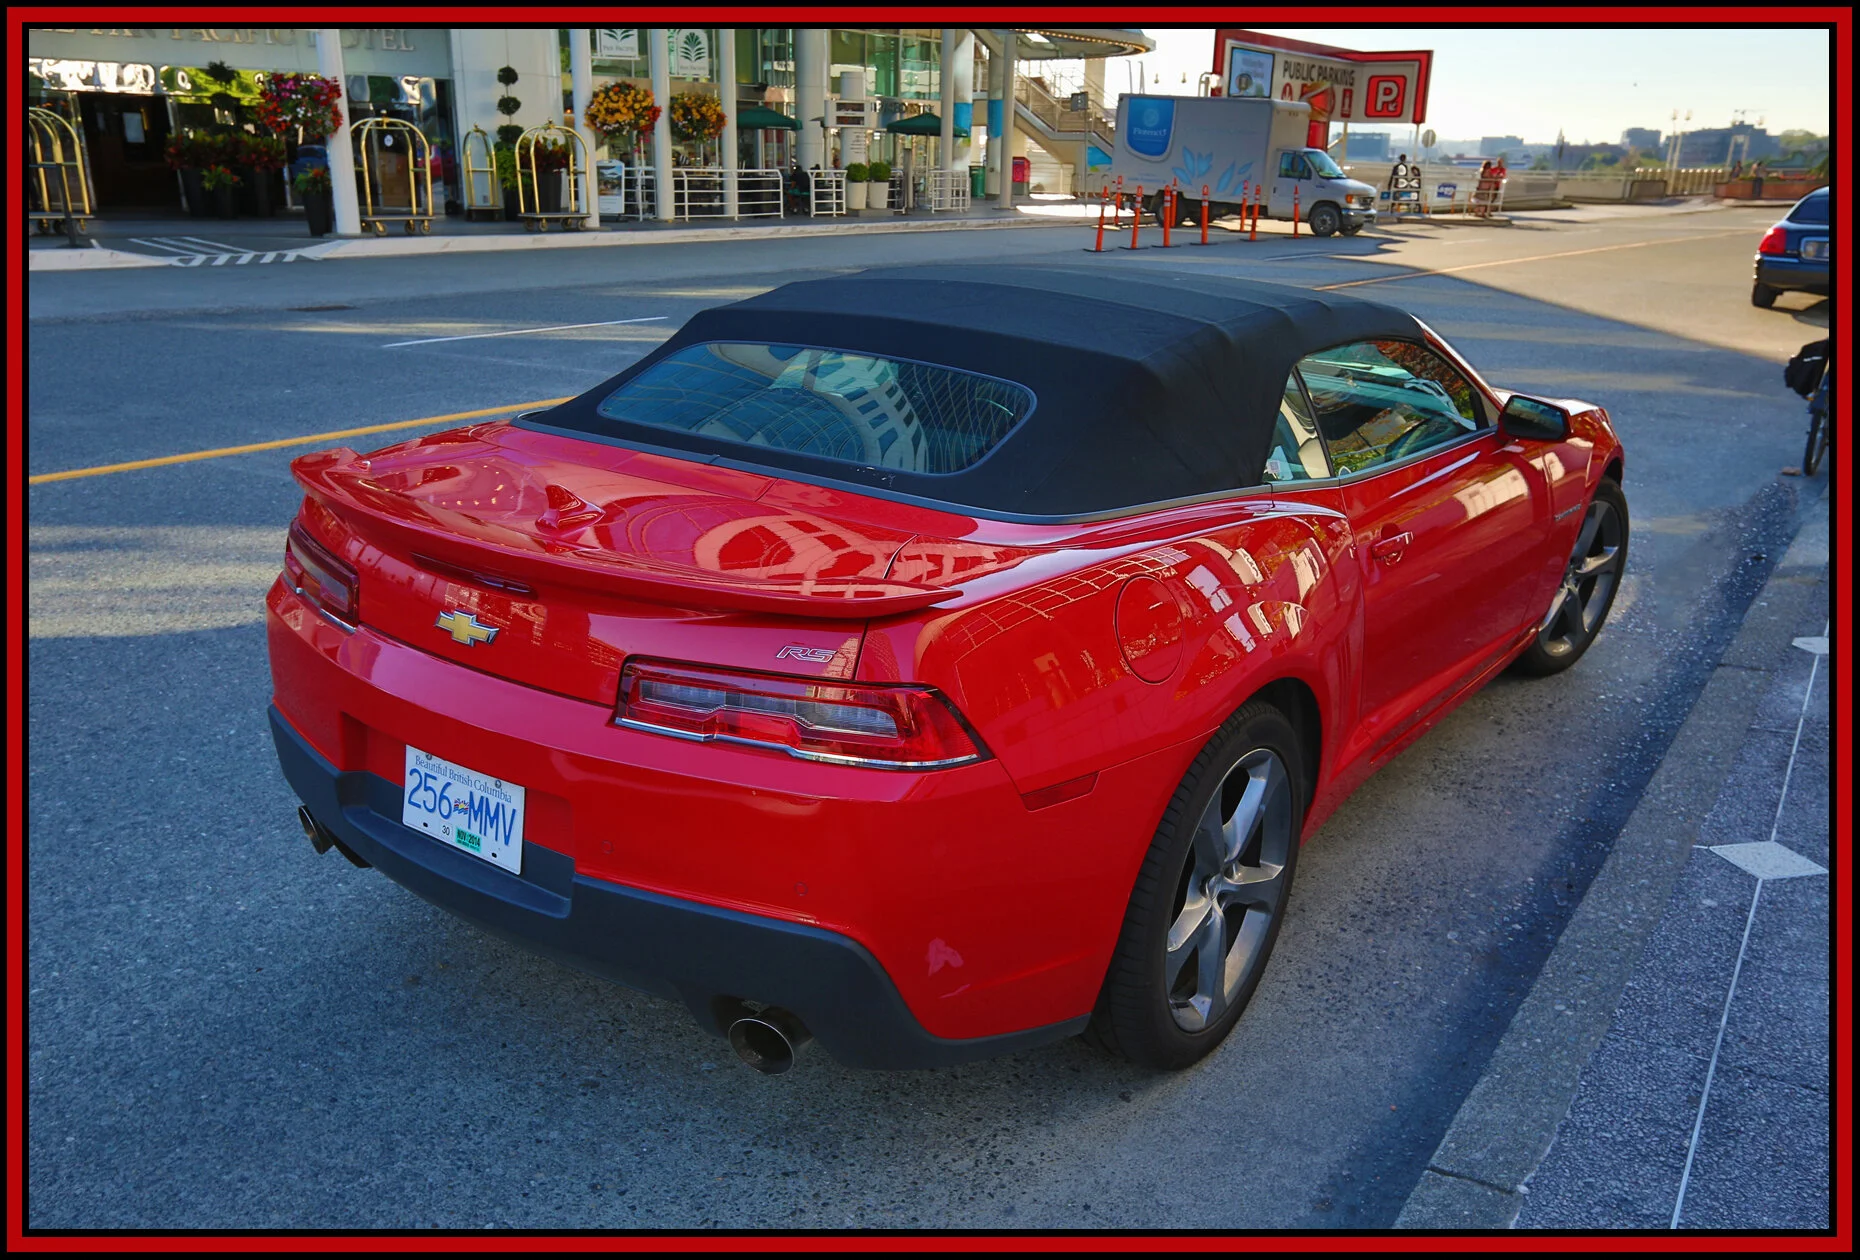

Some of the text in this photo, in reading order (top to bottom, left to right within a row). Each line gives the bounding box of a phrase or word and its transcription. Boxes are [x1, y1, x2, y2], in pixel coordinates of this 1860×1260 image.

[1283, 59, 1316, 82] PUBLIC
[1316, 67, 1356, 87] PARKING
[1375, 80, 1399, 112] P
[776, 645, 839, 663] RS
[415, 755, 512, 804] Beautiful British Columbia
[407, 768, 517, 847] 256 MMV
[442, 825, 451, 836] 30
[457, 828, 467, 841] NOV
[468, 834, 481, 847] 2014
